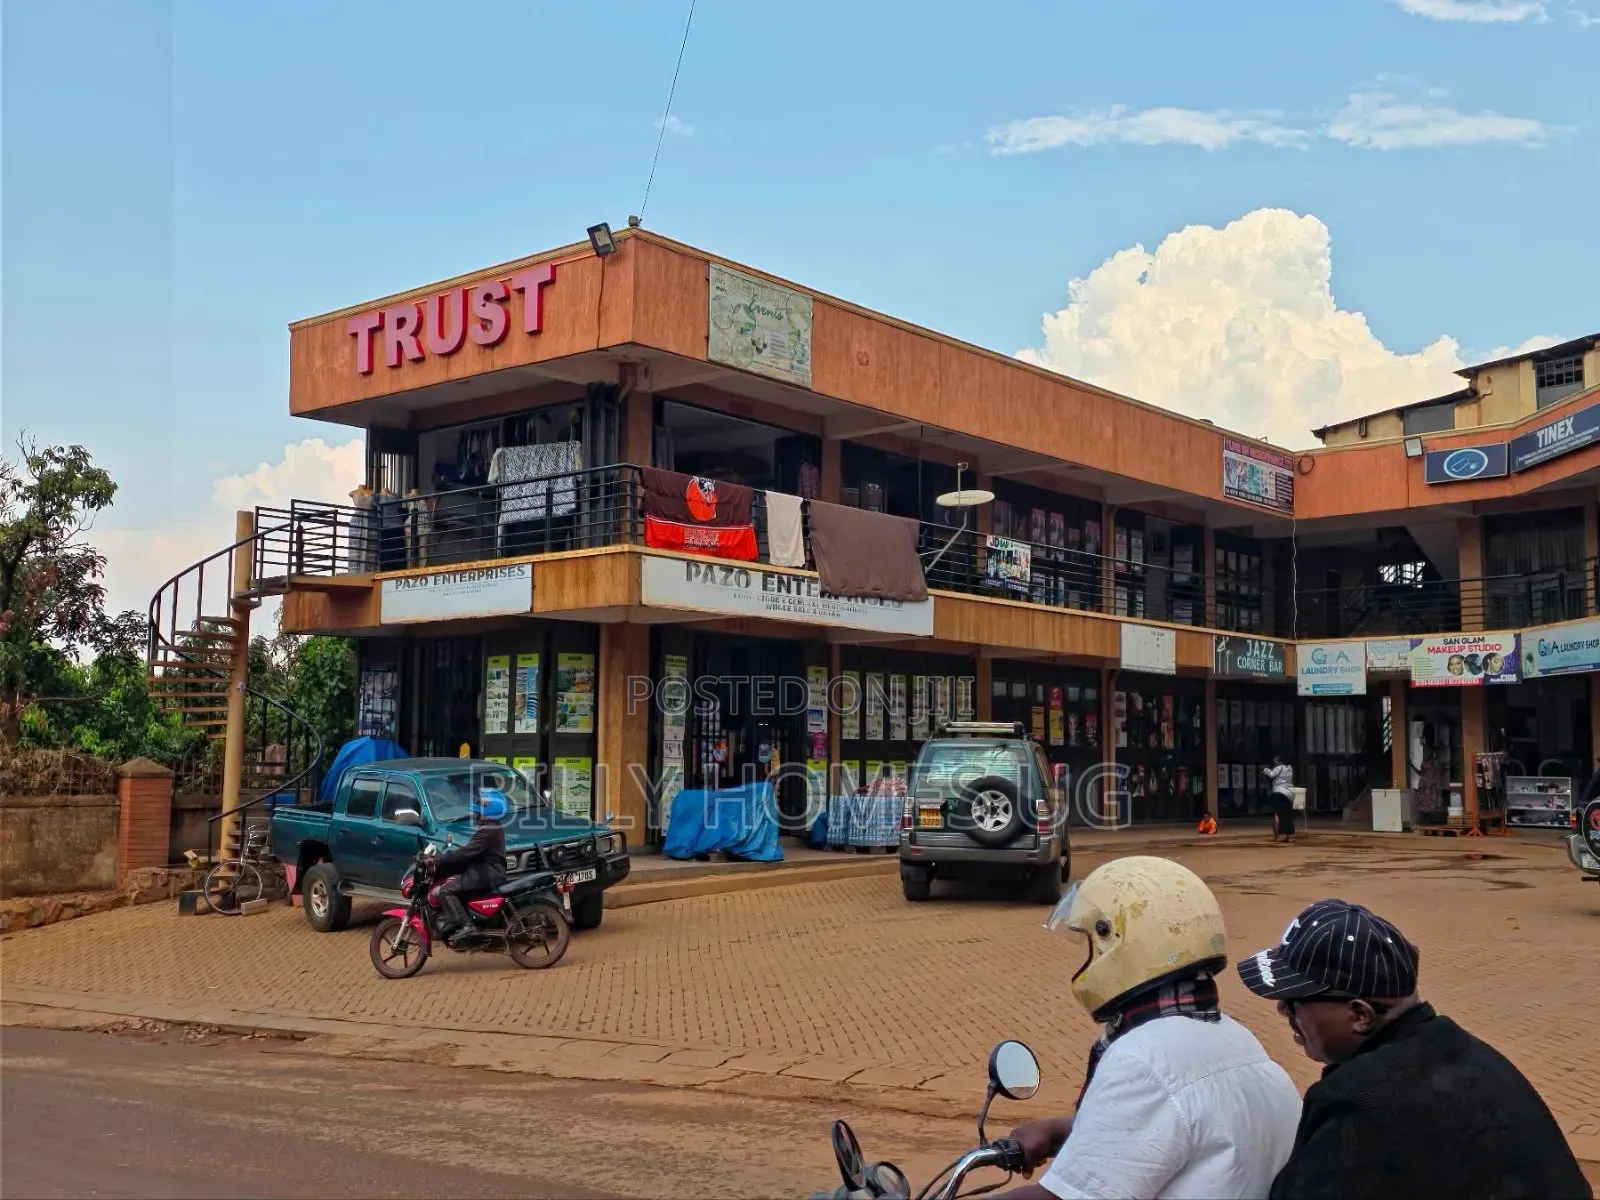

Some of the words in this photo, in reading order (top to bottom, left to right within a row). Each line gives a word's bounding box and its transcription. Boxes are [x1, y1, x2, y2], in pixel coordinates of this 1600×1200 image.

[749, 293, 785, 321] Events
[348, 264, 556, 375] TRUST
[1537, 416, 1575, 448] TINEX
[395, 575, 429, 590] PAZO
[433, 565, 526, 586] ENTERPRISES
[686, 562, 752, 589] PAZO
[1246, 640, 1274, 659] JAZZ
[1427, 645, 1465, 654] MAKEUP
[1467, 643, 1502, 652] STUDIO
[1461, 637, 1485, 645] GLAM
[1561, 642, 1585, 653] LAUNDRY
[1586, 638, 1600, 650] SHOP
[1237, 657, 1265, 670] CORNER
[1269, 660, 1283, 673] BAR
[1302, 667, 1338, 675] LAUNDRY
[1340, 666, 1361, 674] SHOP
